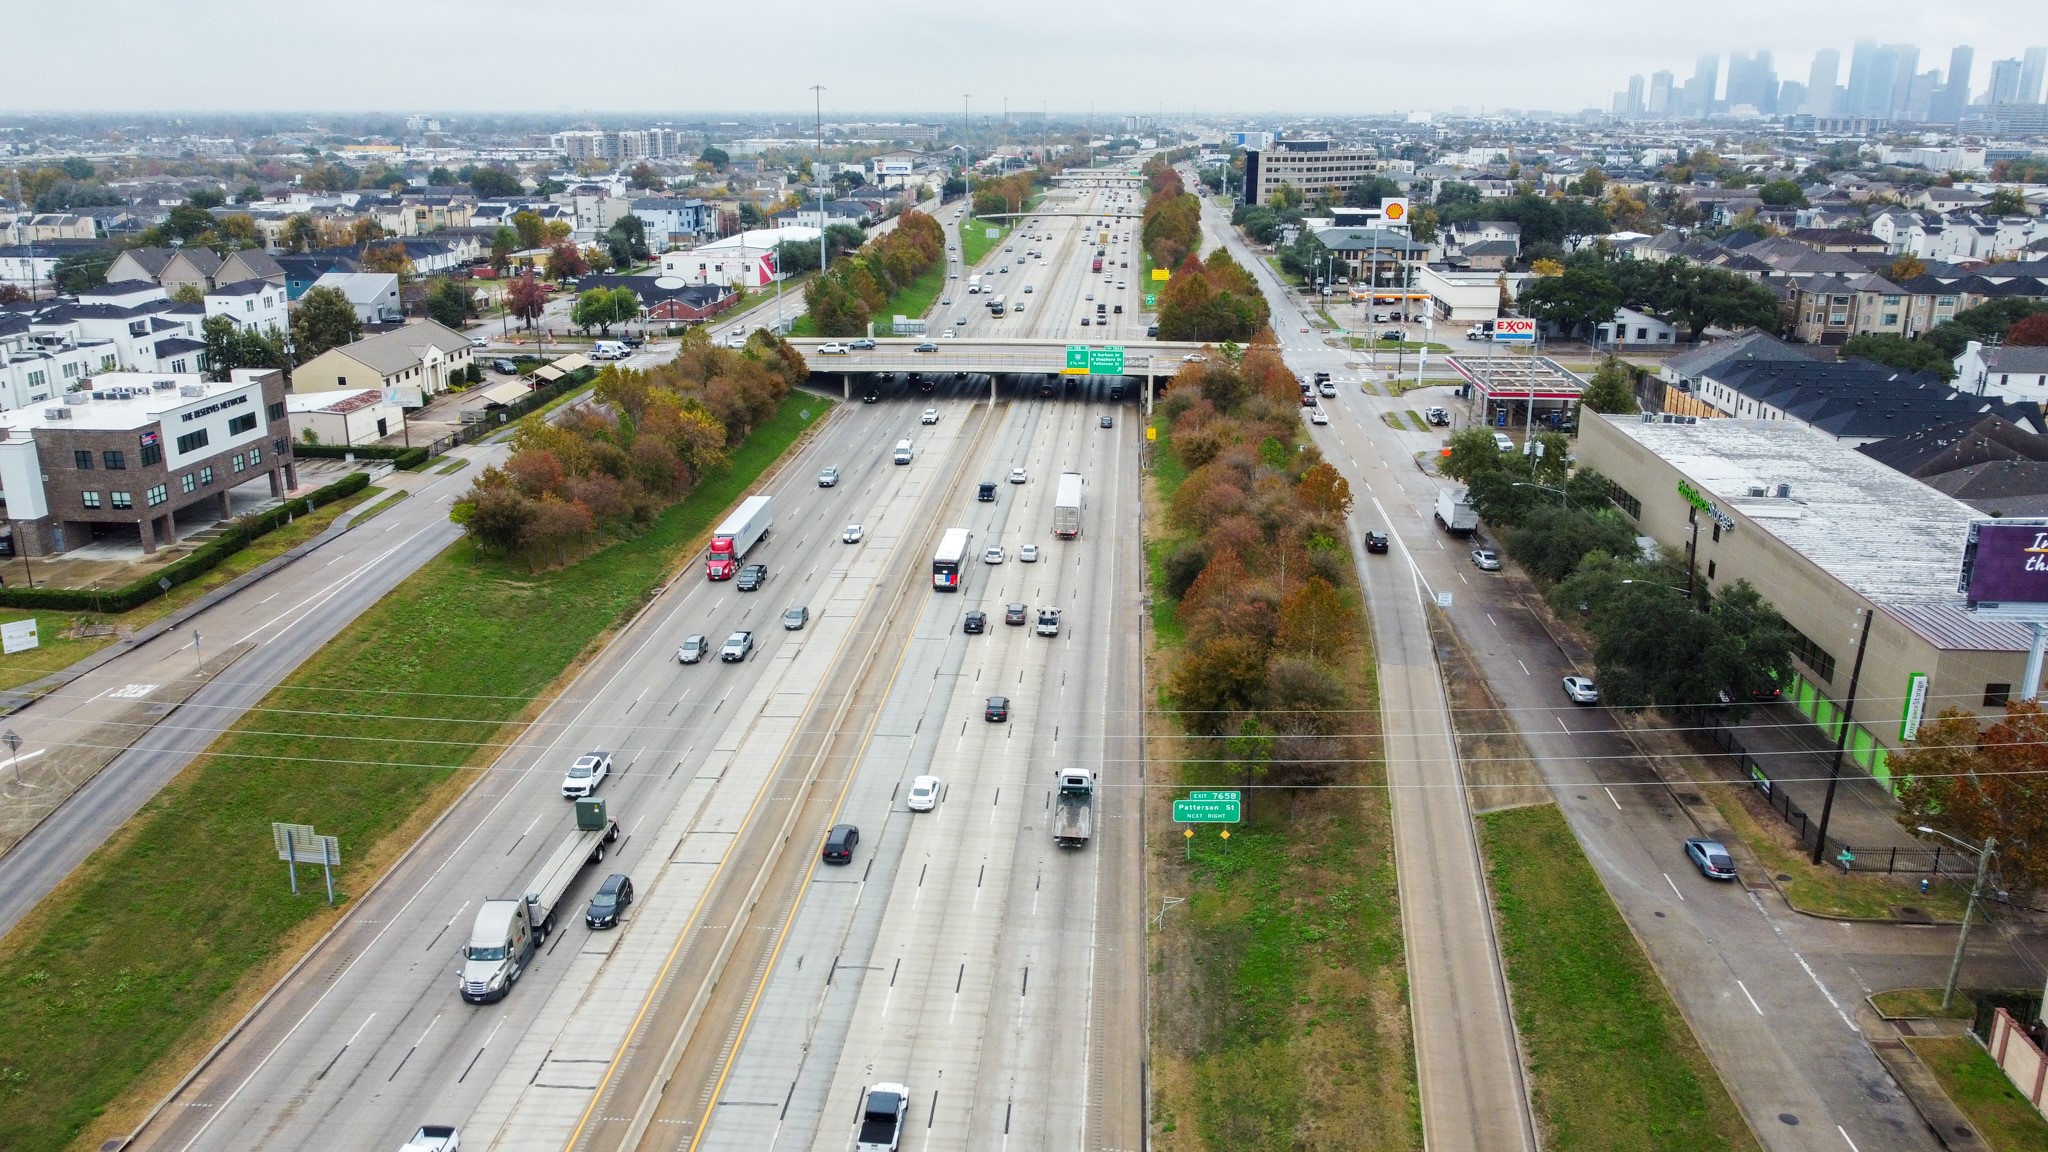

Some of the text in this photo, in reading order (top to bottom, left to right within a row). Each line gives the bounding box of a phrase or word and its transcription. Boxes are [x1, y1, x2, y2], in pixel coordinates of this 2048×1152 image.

[1497, 320, 1533, 333] EXXON
[181, 394, 248, 423] THE RESERVES NETWORK
[2025, 553, 2048, 571] th
[1212, 792, 1237, 800] 765B
